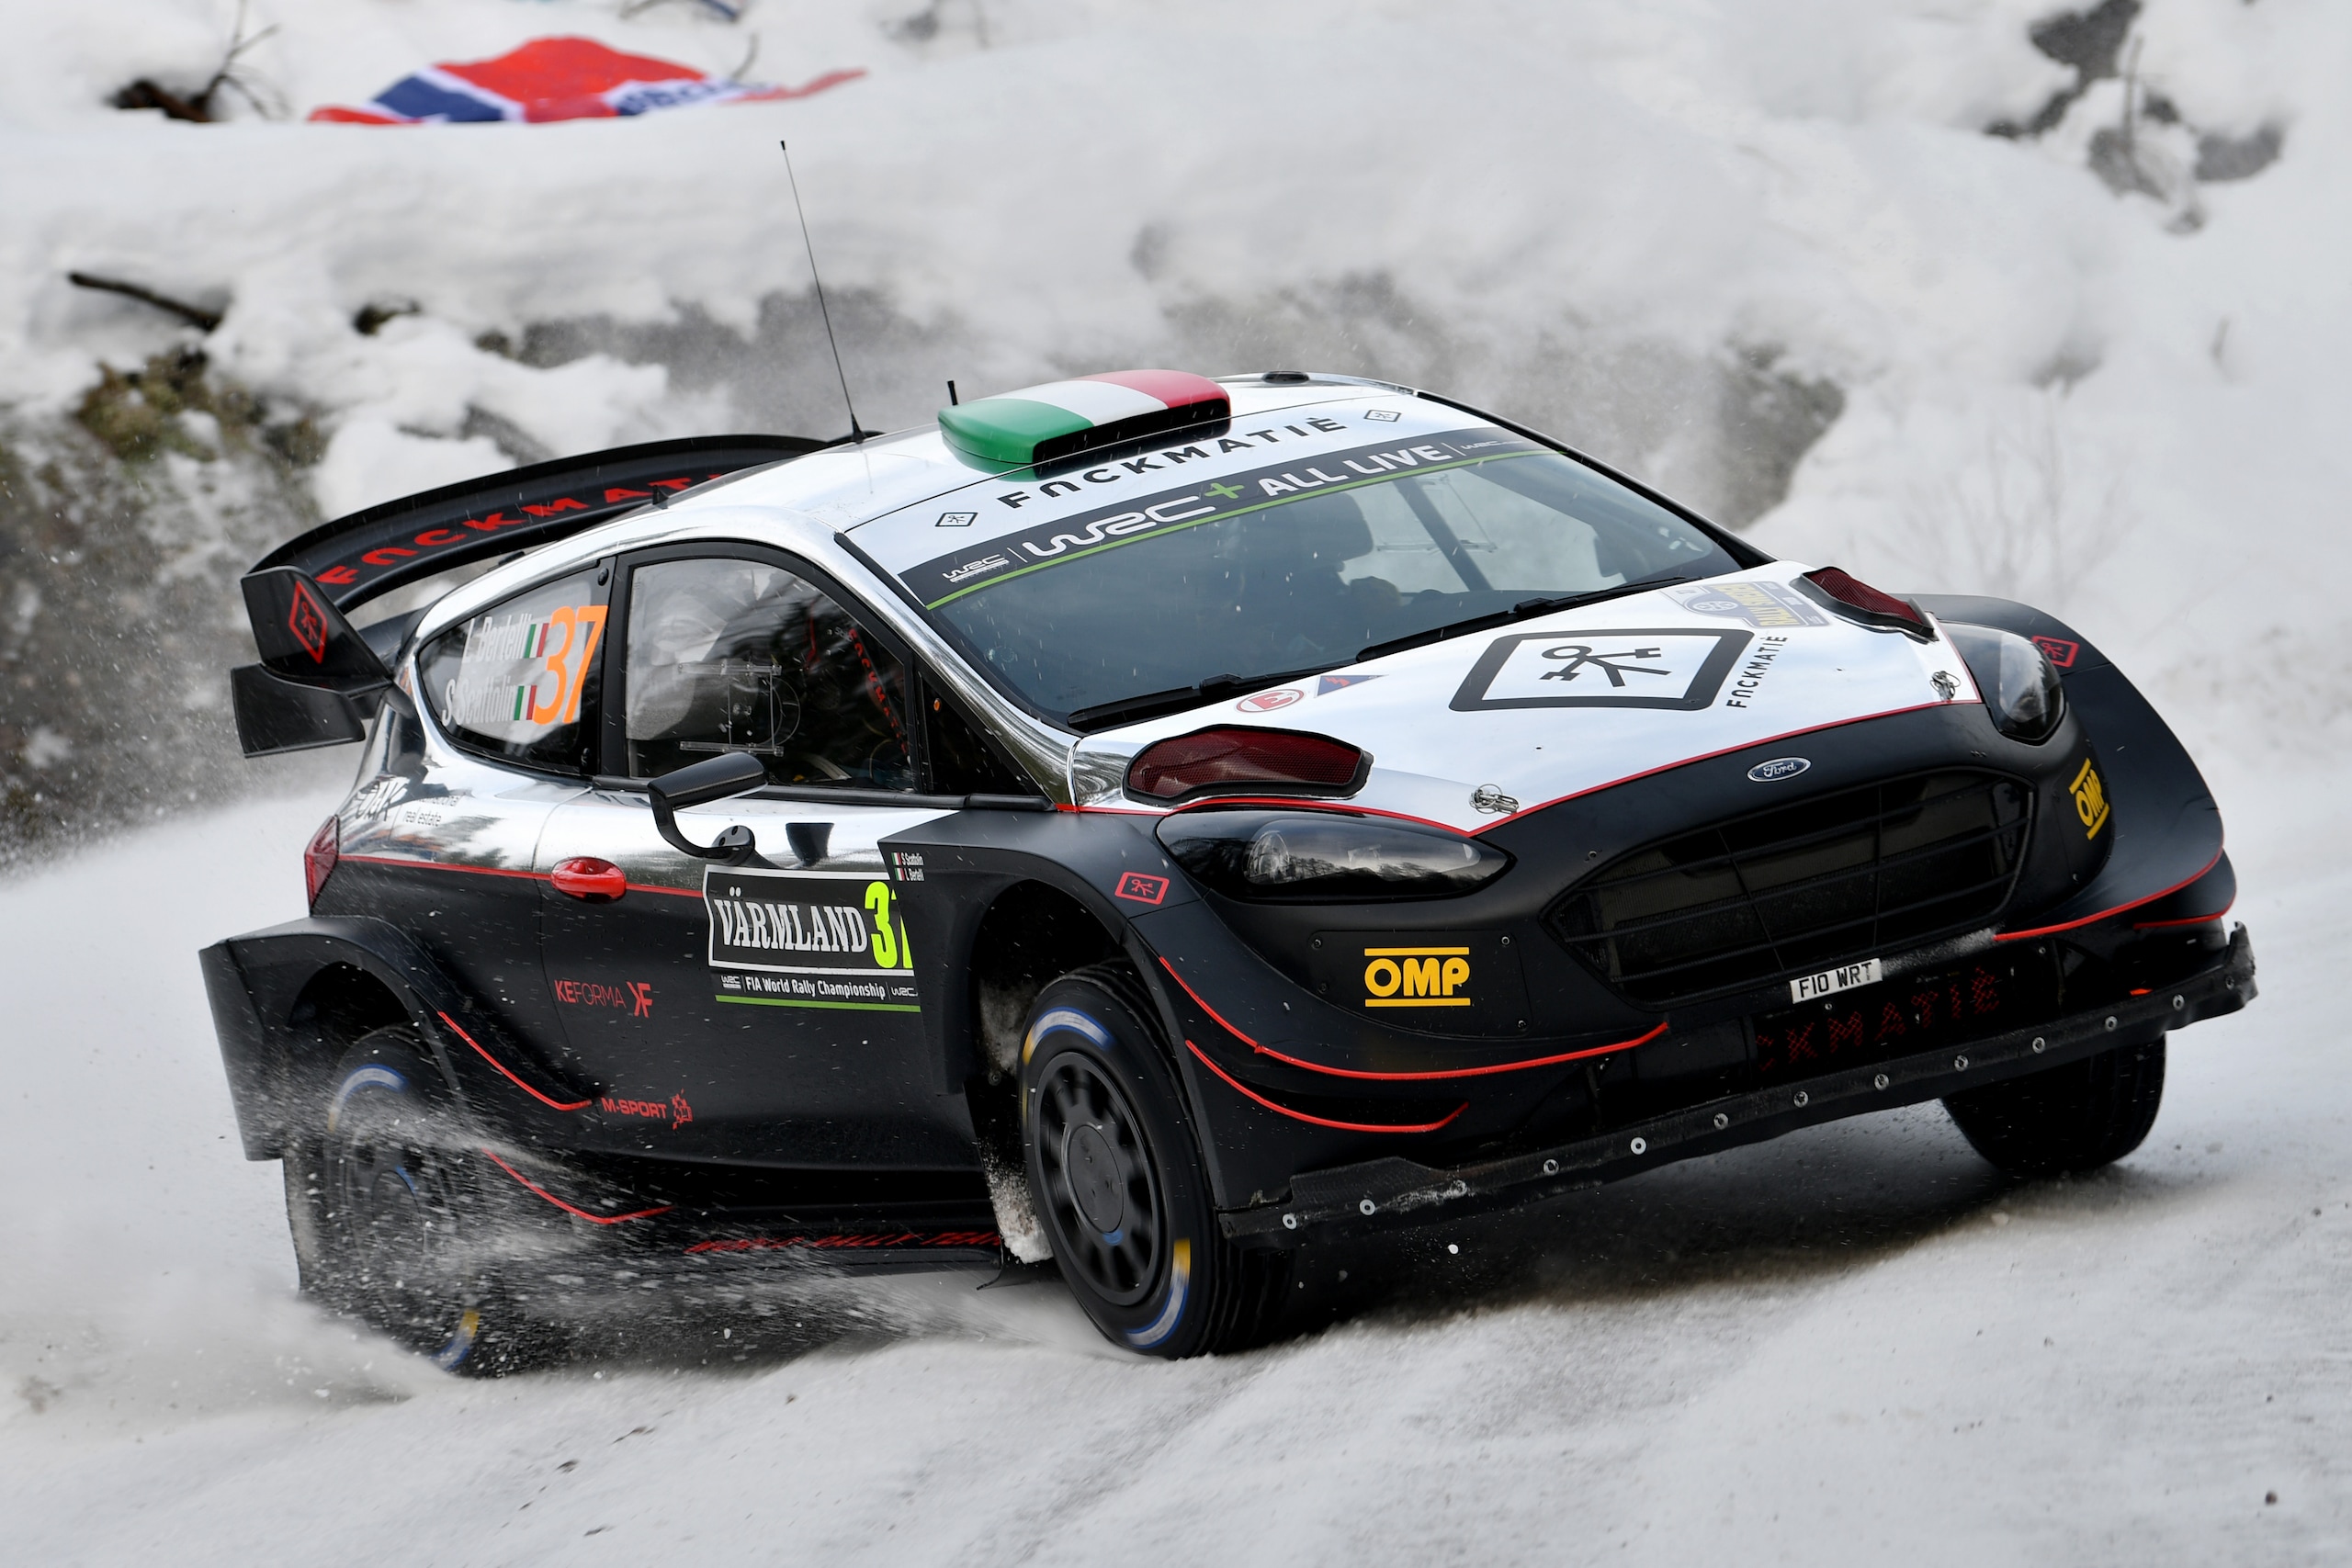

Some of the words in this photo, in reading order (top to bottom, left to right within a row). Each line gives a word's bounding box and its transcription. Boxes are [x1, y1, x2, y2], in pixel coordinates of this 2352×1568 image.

[1258, 468, 1350, 497] ALL
[1342, 445, 1453, 474] LIVE
[532, 604, 609, 726] 37
[1762, 761, 1797, 778] Ford
[2075, 768, 2105, 827] OMP
[713, 886, 868, 953] VÄRMLAND
[745, 976, 762, 991] FIA
[762, 976, 790, 994] World
[791, 979, 816, 998] Rally
[818, 979, 886, 1000] Championship
[1363, 956, 1470, 998] OMP
[1836, 962, 1872, 988] WRT
[553, 979, 628, 1010] KEFORMA
[601, 1097, 667, 1120] M-SPORT
